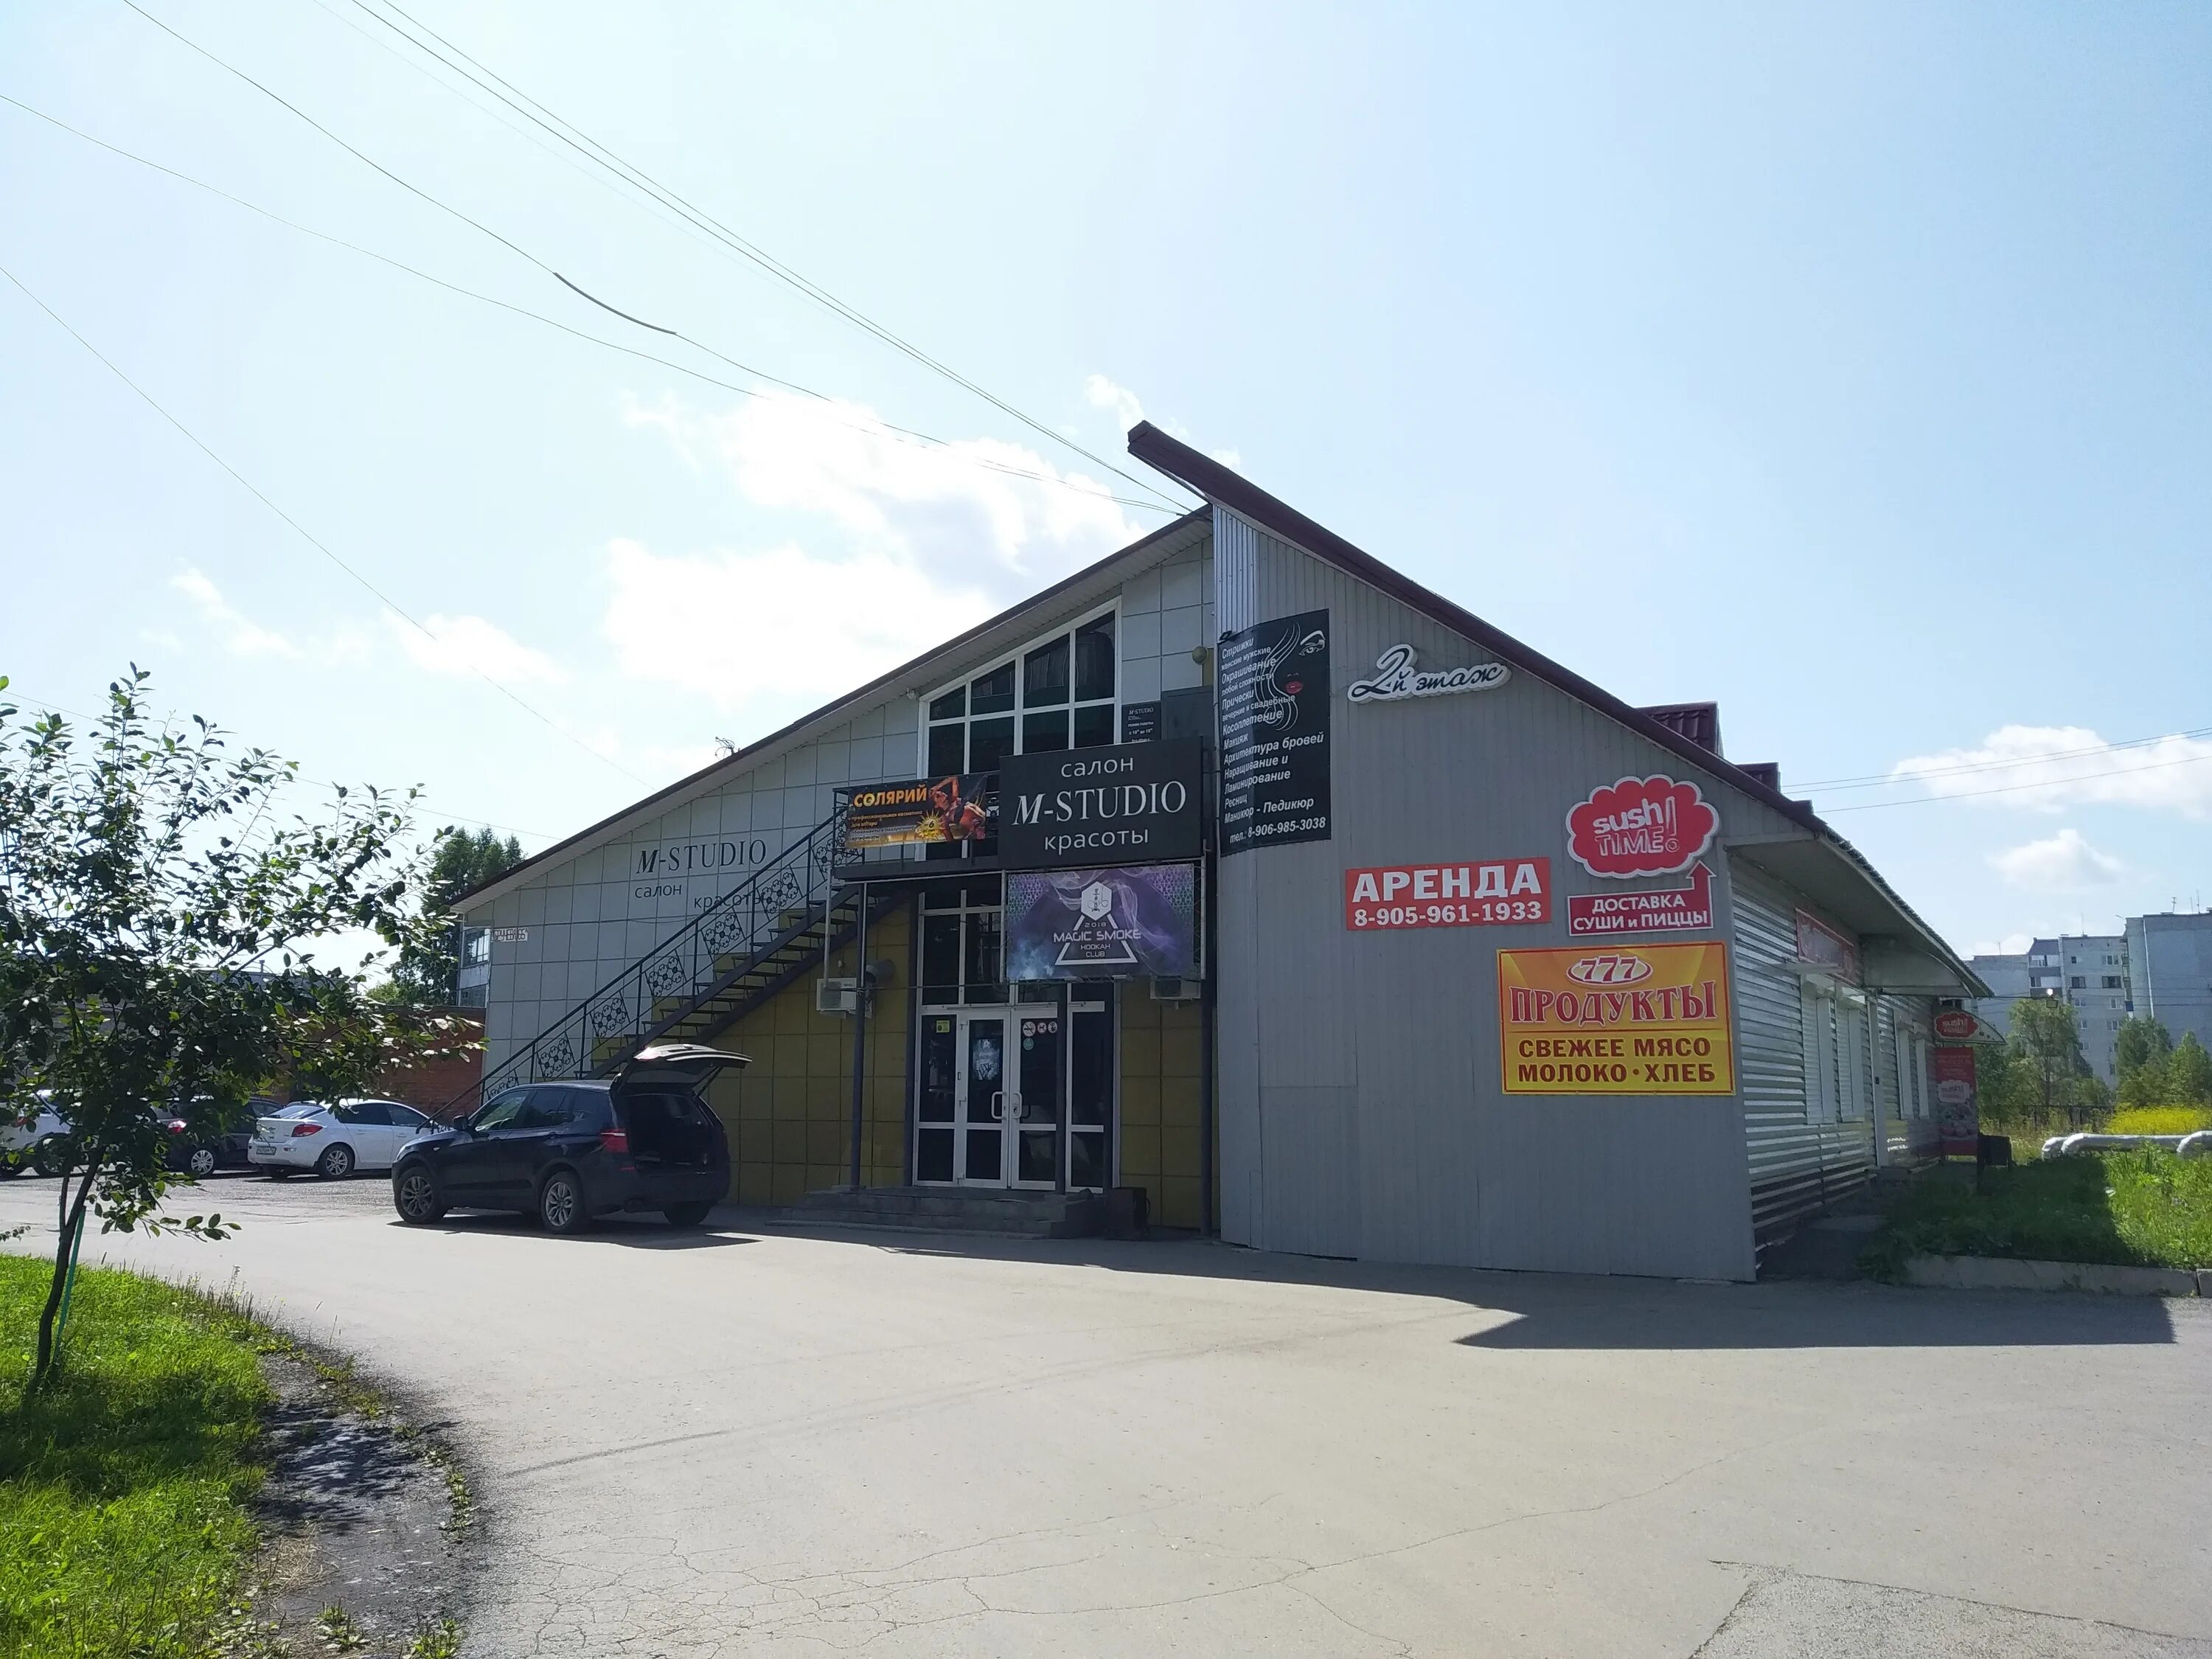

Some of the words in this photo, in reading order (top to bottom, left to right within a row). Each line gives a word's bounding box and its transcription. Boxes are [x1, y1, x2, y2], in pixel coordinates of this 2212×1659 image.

[1222, 638, 1253, 658] Стрижки
[1243, 647, 1271, 661] мужские
[1222, 658, 1276, 684] Окрашивание
[1239, 672, 1274, 688] сложности
[1416, 667, 1503, 691] этаж
[1222, 689, 1253, 711] Прически
[1251, 695, 1295, 709] свадебные
[1223, 710, 1282, 736] Косоплетение
[1223, 733, 1248, 751] Макияж
[1223, 741, 1279, 765] Архитектура
[1282, 731, 1324, 750] бровей
[1060, 757, 1133, 777] салон
[1225, 756, 1279, 779] Наращивание
[1281, 755, 1289, 765] и
[1225, 771, 1290, 795] Ламинирование
[854, 784, 927, 807] СОЛЯРИЙ
[1012, 780, 1186, 825] M-STUDIO
[1225, 793, 1248, 809] Ресниц
[1225, 807, 1253, 824] Маникюр
[1263, 798, 1314, 814] Педикюр
[1248, 816, 1326, 838] 8-906-985-3038
[1045, 829, 1149, 855] красоты
[636, 839, 766, 874] M-STUDIO
[635, 884, 681, 898] салон
[1352, 863, 1542, 903] АРЕНДА
[1354, 901, 1542, 927] 8-905-961-1933
[1593, 894, 1686, 914] ДОСТАВКА
[1573, 916, 1624, 931] СУШИ
[1628, 919, 1637, 928] и
[1641, 911, 1708, 927] ПИЦЦЫ
[1054, 931, 1092, 942] MAGIC
[1096, 929, 1141, 941] SMOKE
[1579, 954, 1637, 982] 777
[1509, 981, 1717, 1026] ПРОДУКТЫ
[1518, 1038, 1625, 1058] СВЕЖЕЕ
[1633, 1037, 1711, 1057] МЯСО
[1517, 1063, 1627, 1082] МОЛОКО
[1644, 1063, 1716, 1082] ХЛЕБ
